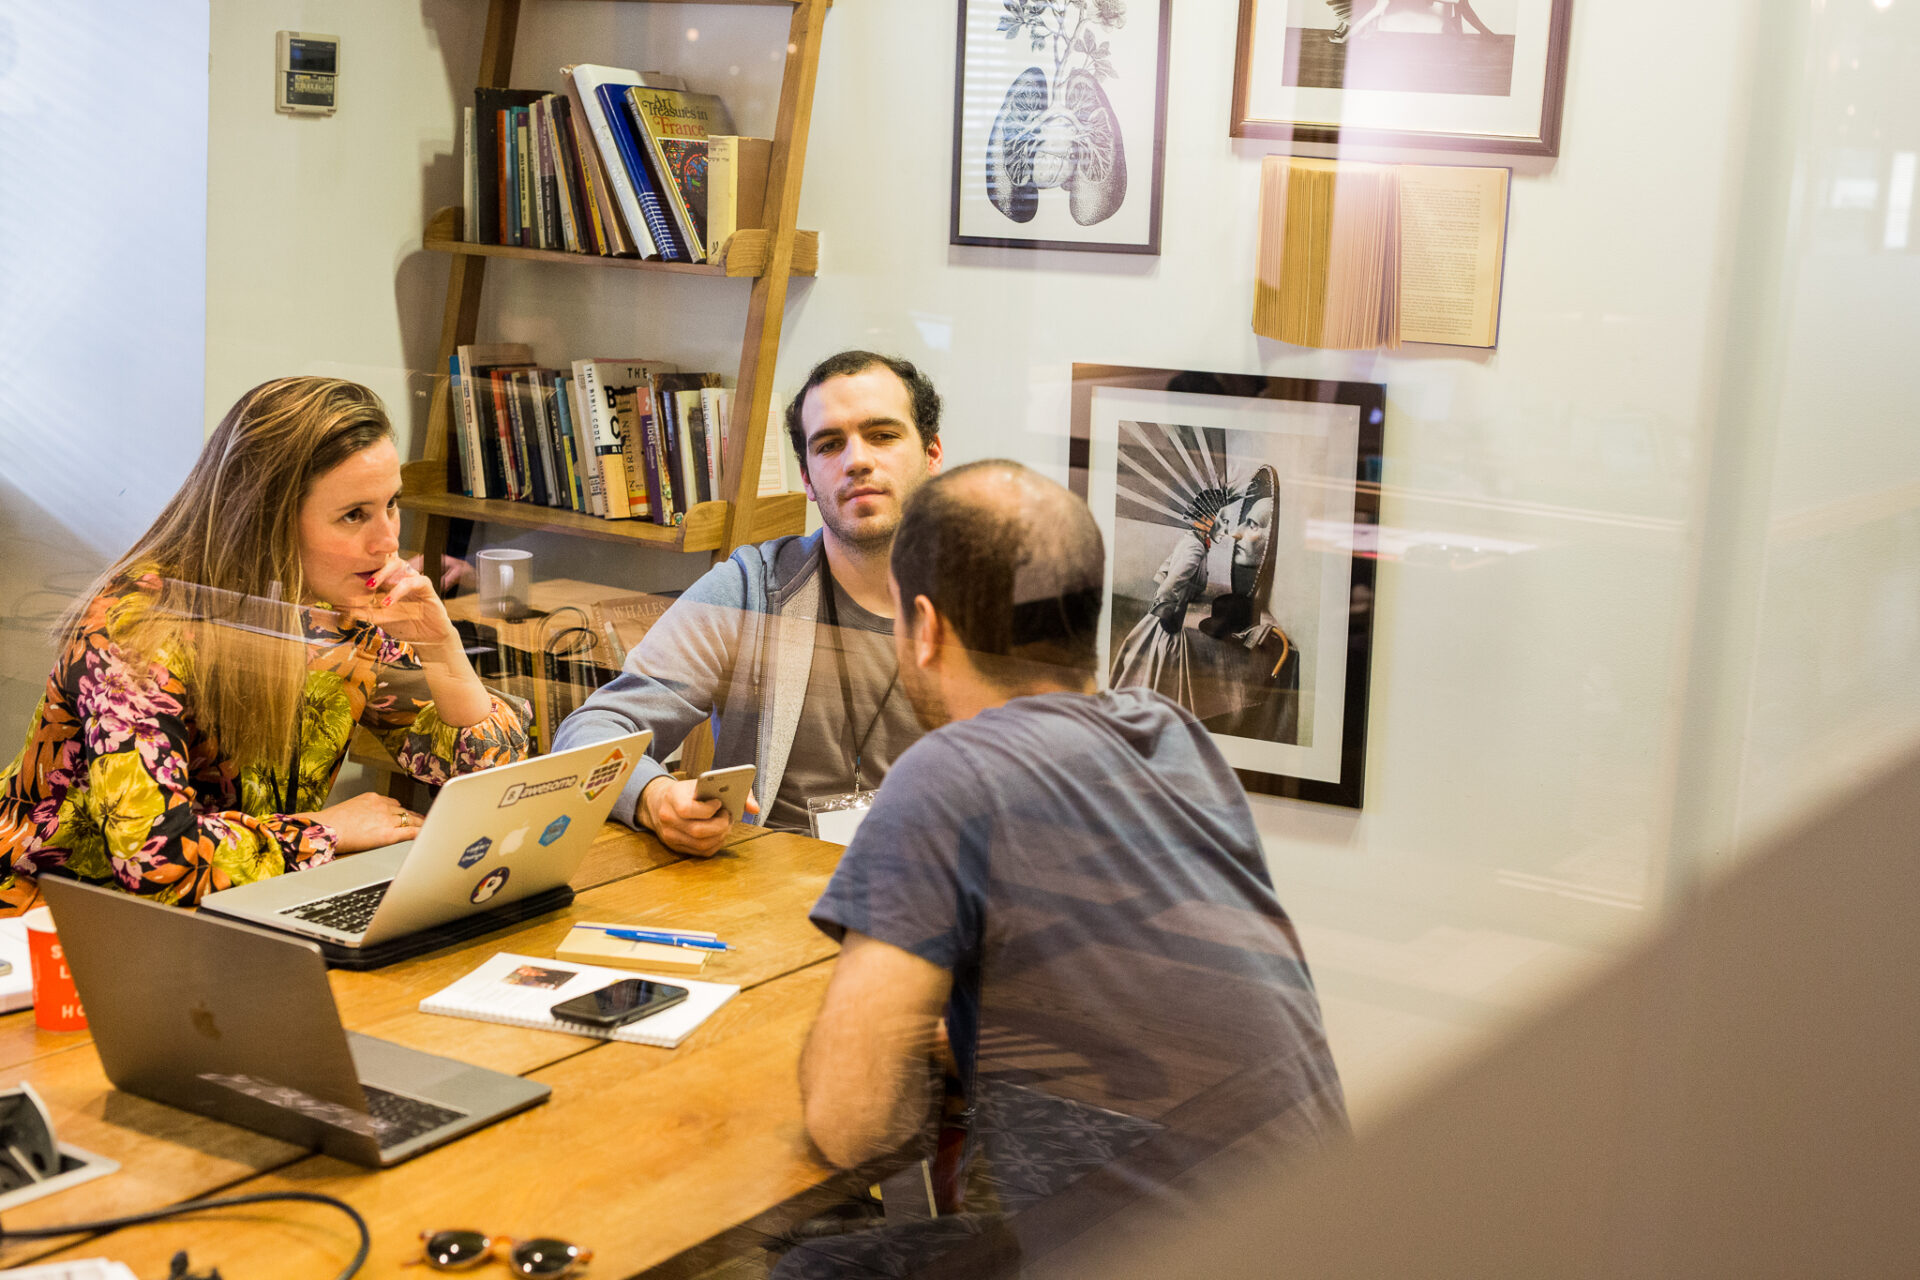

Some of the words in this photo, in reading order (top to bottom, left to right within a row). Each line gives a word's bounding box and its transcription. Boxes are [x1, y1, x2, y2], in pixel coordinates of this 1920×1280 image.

[642, 99, 697, 119] Treasures
[696, 106, 709, 120] in
[653, 93, 672, 110] Art
[653, 115, 706, 137] France
[586, 367, 594, 383] THE
[627, 367, 648, 379] THE
[589, 388, 598, 414] BIBLE
[592, 418, 602, 441] CODE
[613, 601, 666, 618] WHALES
[520, 776, 577, 799] awesome
